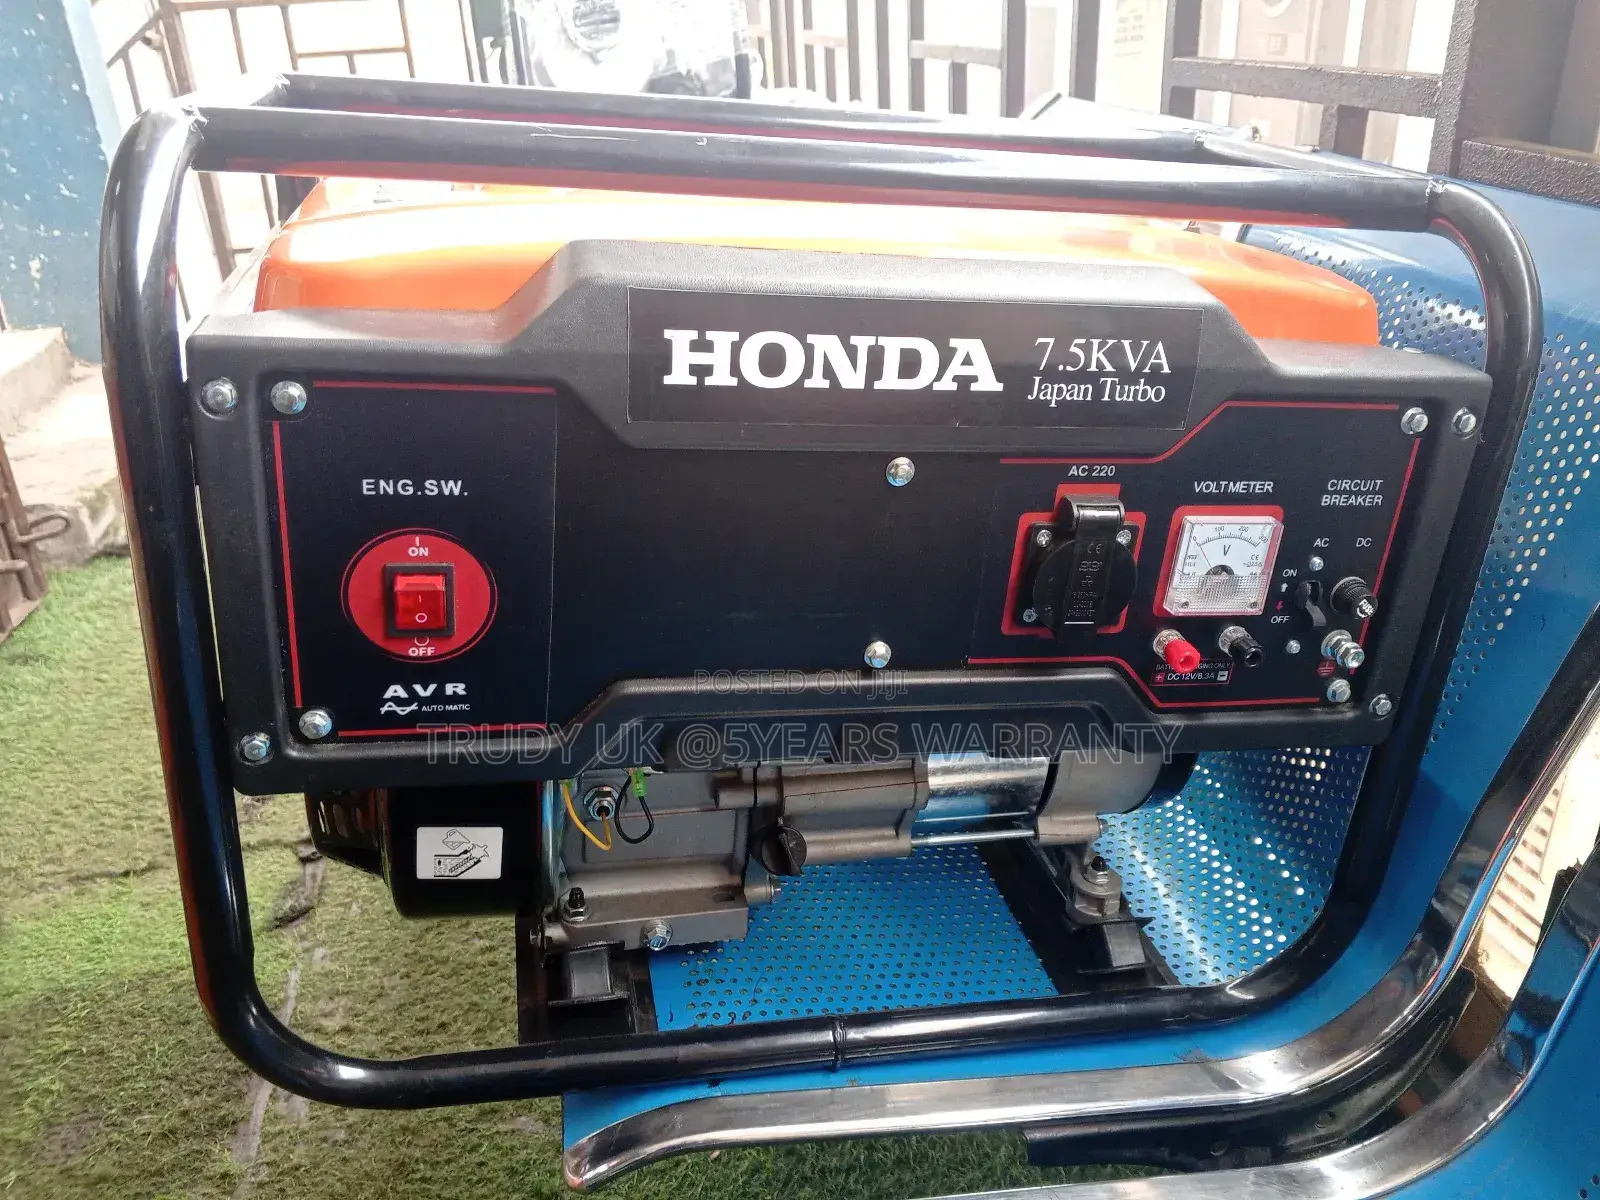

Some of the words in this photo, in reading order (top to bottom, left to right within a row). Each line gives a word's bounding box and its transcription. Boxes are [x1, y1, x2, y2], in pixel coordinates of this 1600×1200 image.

[662, 328, 1004, 393] HONDA
[1034, 337, 1171, 374] 7.5KVA
[1027, 376, 1092, 408] Japan
[1099, 377, 1166, 403] Turbo
[1068, 465, 1089, 477] AC
[1091, 465, 1117, 477] 220
[361, 478, 470, 497] ENG.SW.
[1327, 479, 1384, 492] CIRCUIT
[1320, 494, 1384, 507] BREAKER
[1313, 537, 1330, 548] AC
[1355, 537, 1373, 548] DC
[407, 547, 430, 557] ON
[1223, 544, 1232, 557] V
[1282, 568, 1298, 578] ON
[1270, 615, 1290, 625] OFF
[408, 647, 436, 657] OFF
[421, 704, 444, 712] AUTO
[445, 702, 471, 711] MATIC
